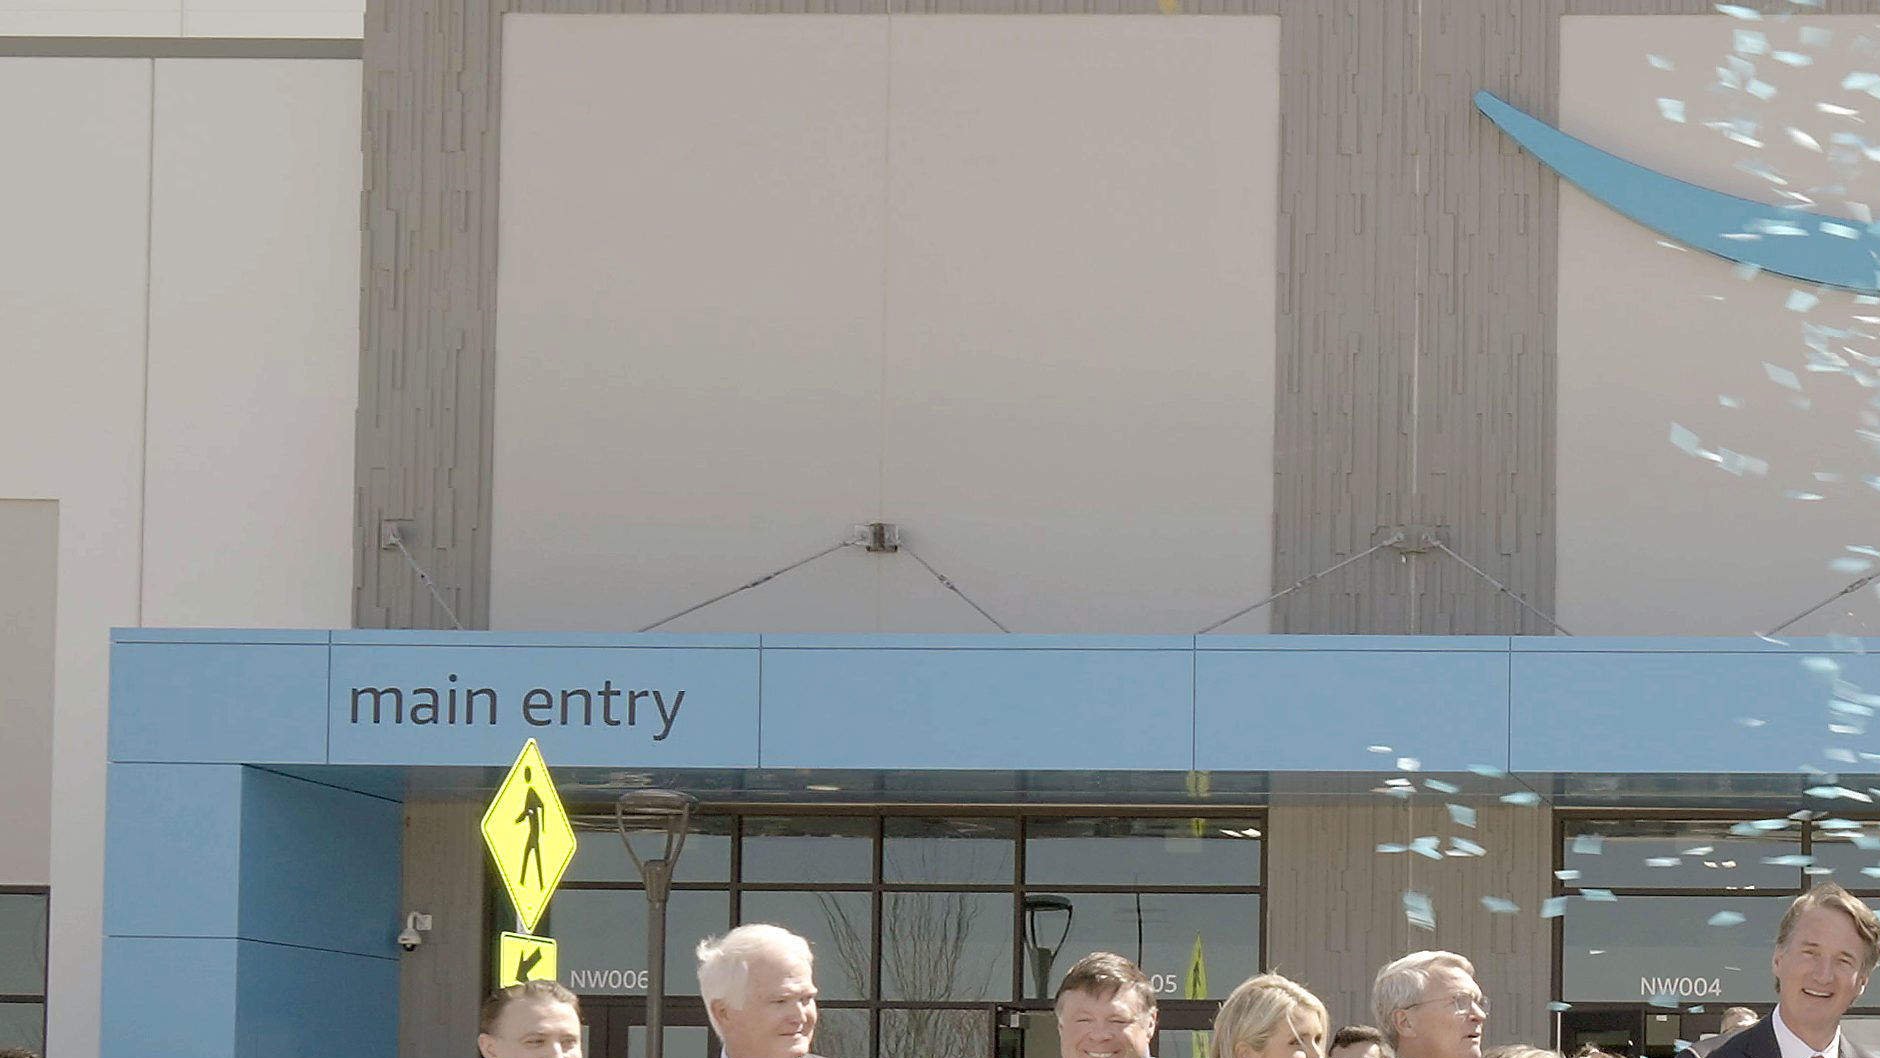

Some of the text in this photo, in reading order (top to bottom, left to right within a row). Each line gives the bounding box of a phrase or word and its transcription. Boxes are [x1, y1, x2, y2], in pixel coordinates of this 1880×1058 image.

[351, 673, 686, 741] main entry
[569, 969, 649, 989] NW006
[1640, 976, 1722, 997] NW004
